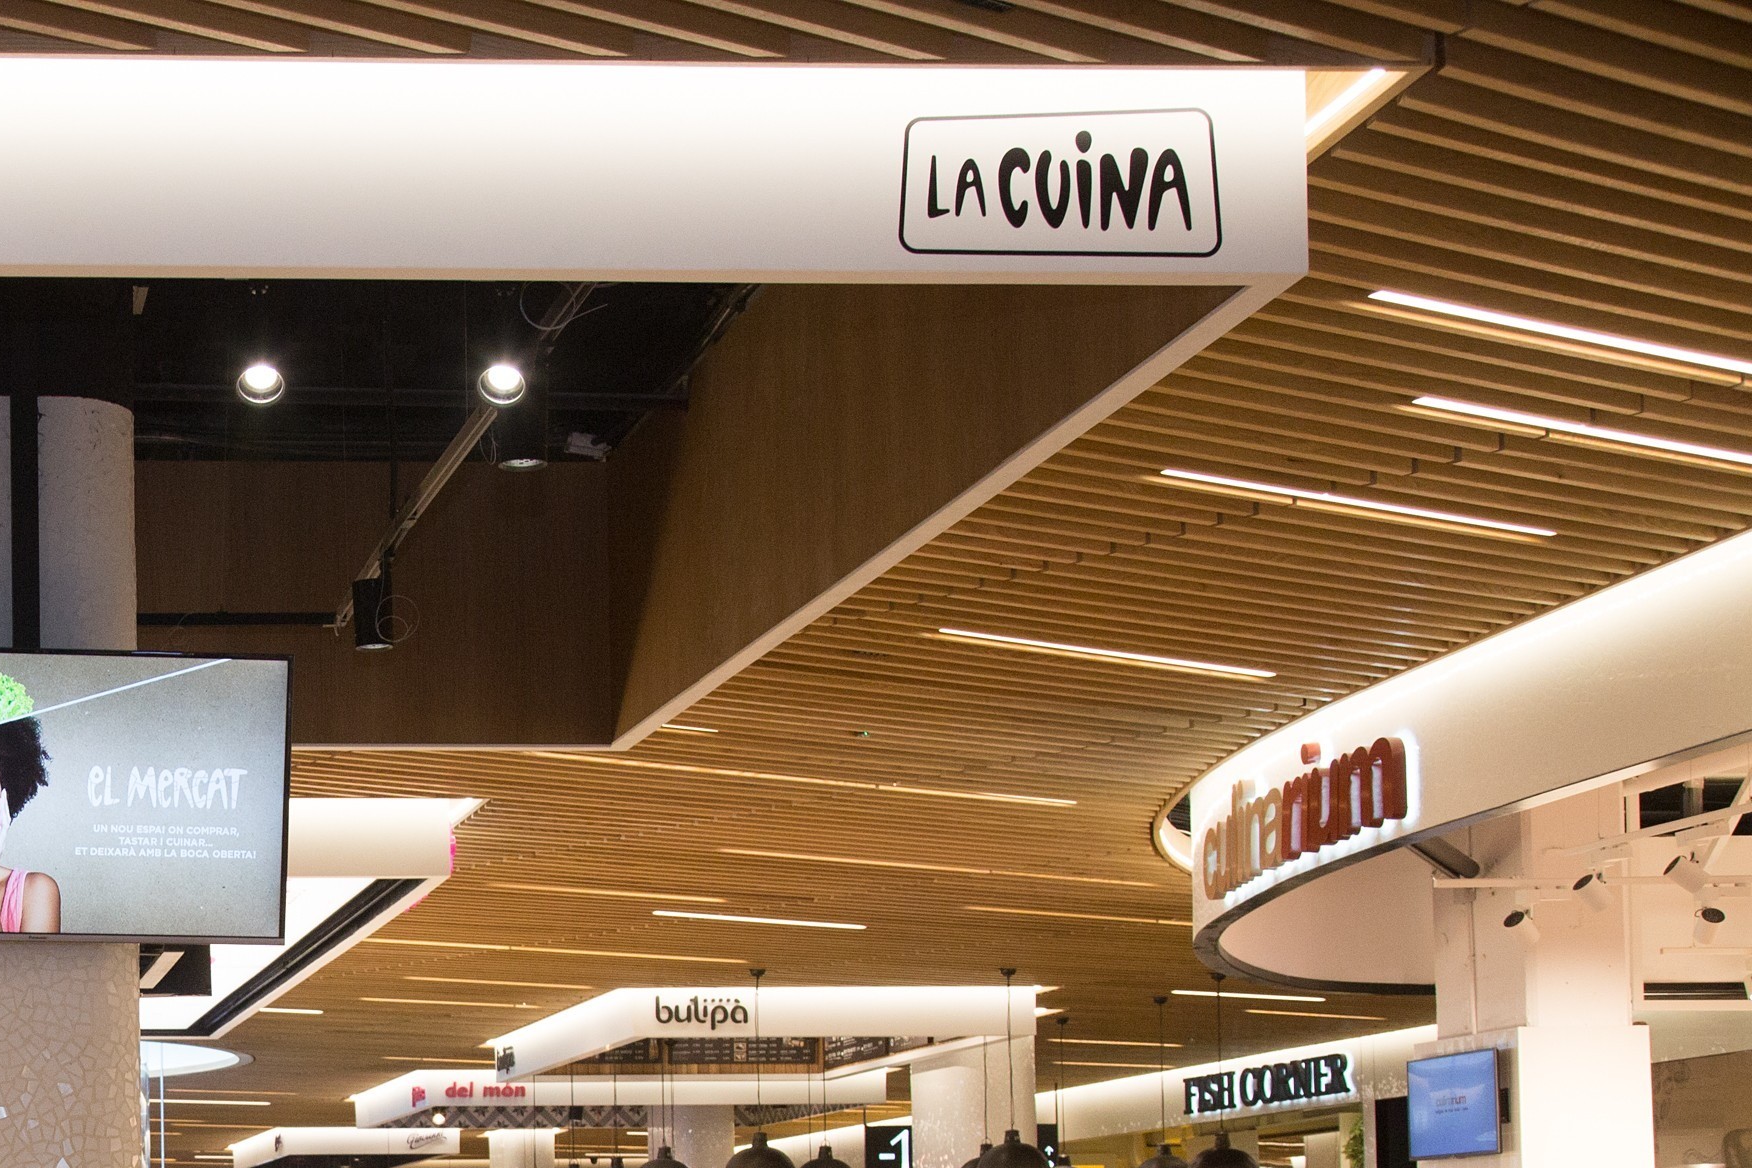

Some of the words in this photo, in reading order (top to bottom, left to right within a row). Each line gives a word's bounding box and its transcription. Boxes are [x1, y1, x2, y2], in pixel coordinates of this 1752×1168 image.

[928, 155, 986, 218] LA
[1204, 737, 1408, 900] culinarium
[93, 824, 107, 833] UN
[110, 824, 133, 834] NOU
[136, 825, 165, 834] ESPAI
[168, 826, 184, 834] ON
[186, 826, 240, 837] COMPRAR,
[118, 836, 158, 846] TASTAR
[166, 837, 213, 847] CUINAR...
[75, 847, 88, 855] ET
[139, 849, 161, 858] AMB
[164, 849, 178, 858] LA
[180, 849, 209, 858] BOCA
[212, 850, 256, 859] OBERTA!
[445, 1081, 474, 1098] del
[1183, 1071, 1237, 1115] FISH
[1240, 1053, 1351, 1106] CORNER
